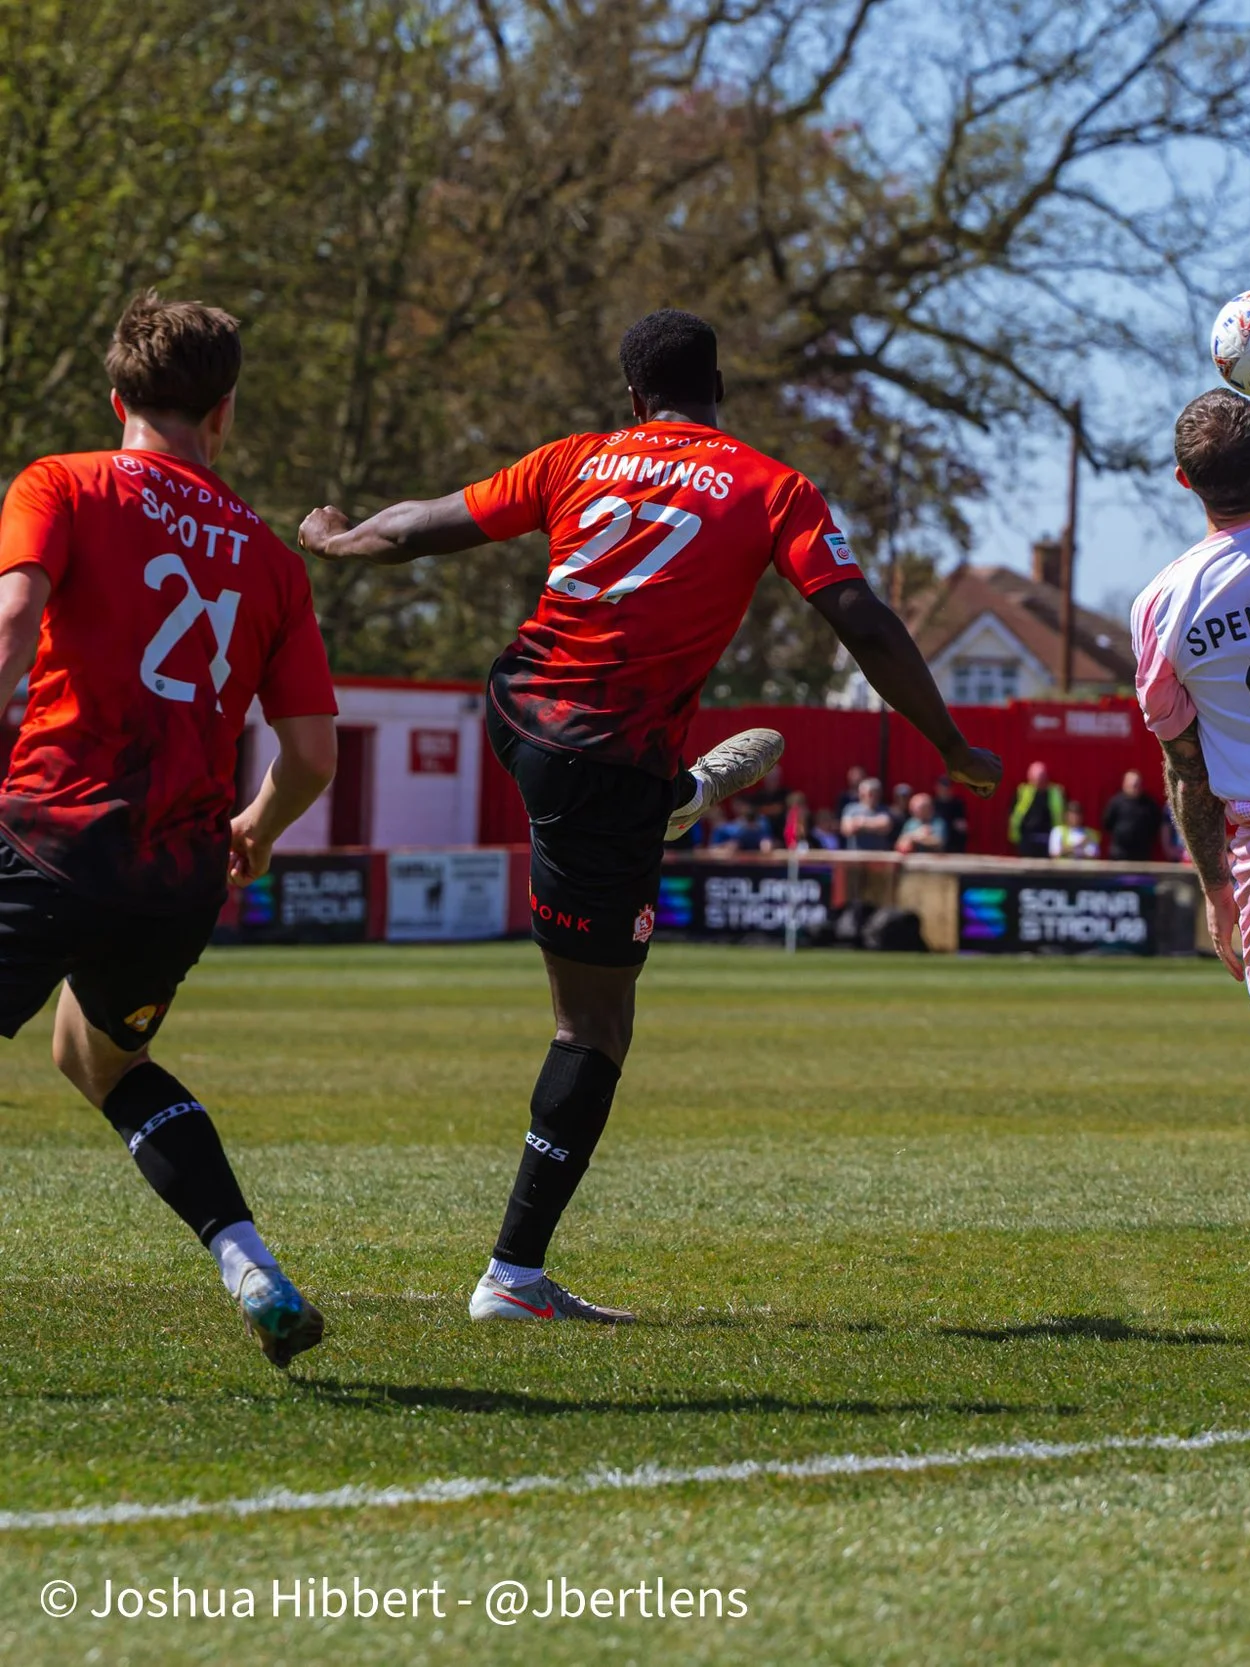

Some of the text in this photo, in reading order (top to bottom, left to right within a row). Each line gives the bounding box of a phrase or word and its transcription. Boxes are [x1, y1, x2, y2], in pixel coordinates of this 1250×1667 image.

[631, 430, 738, 454] RAYDIUM
[149, 465, 260, 525] RAYDIUM
[577, 453, 734, 500] CUMMINGS
[141, 487, 249, 565] SCOTT
[547, 495, 702, 604] 27
[139, 553, 242, 714] 21
[525, 1131, 570, 1163] EDS
